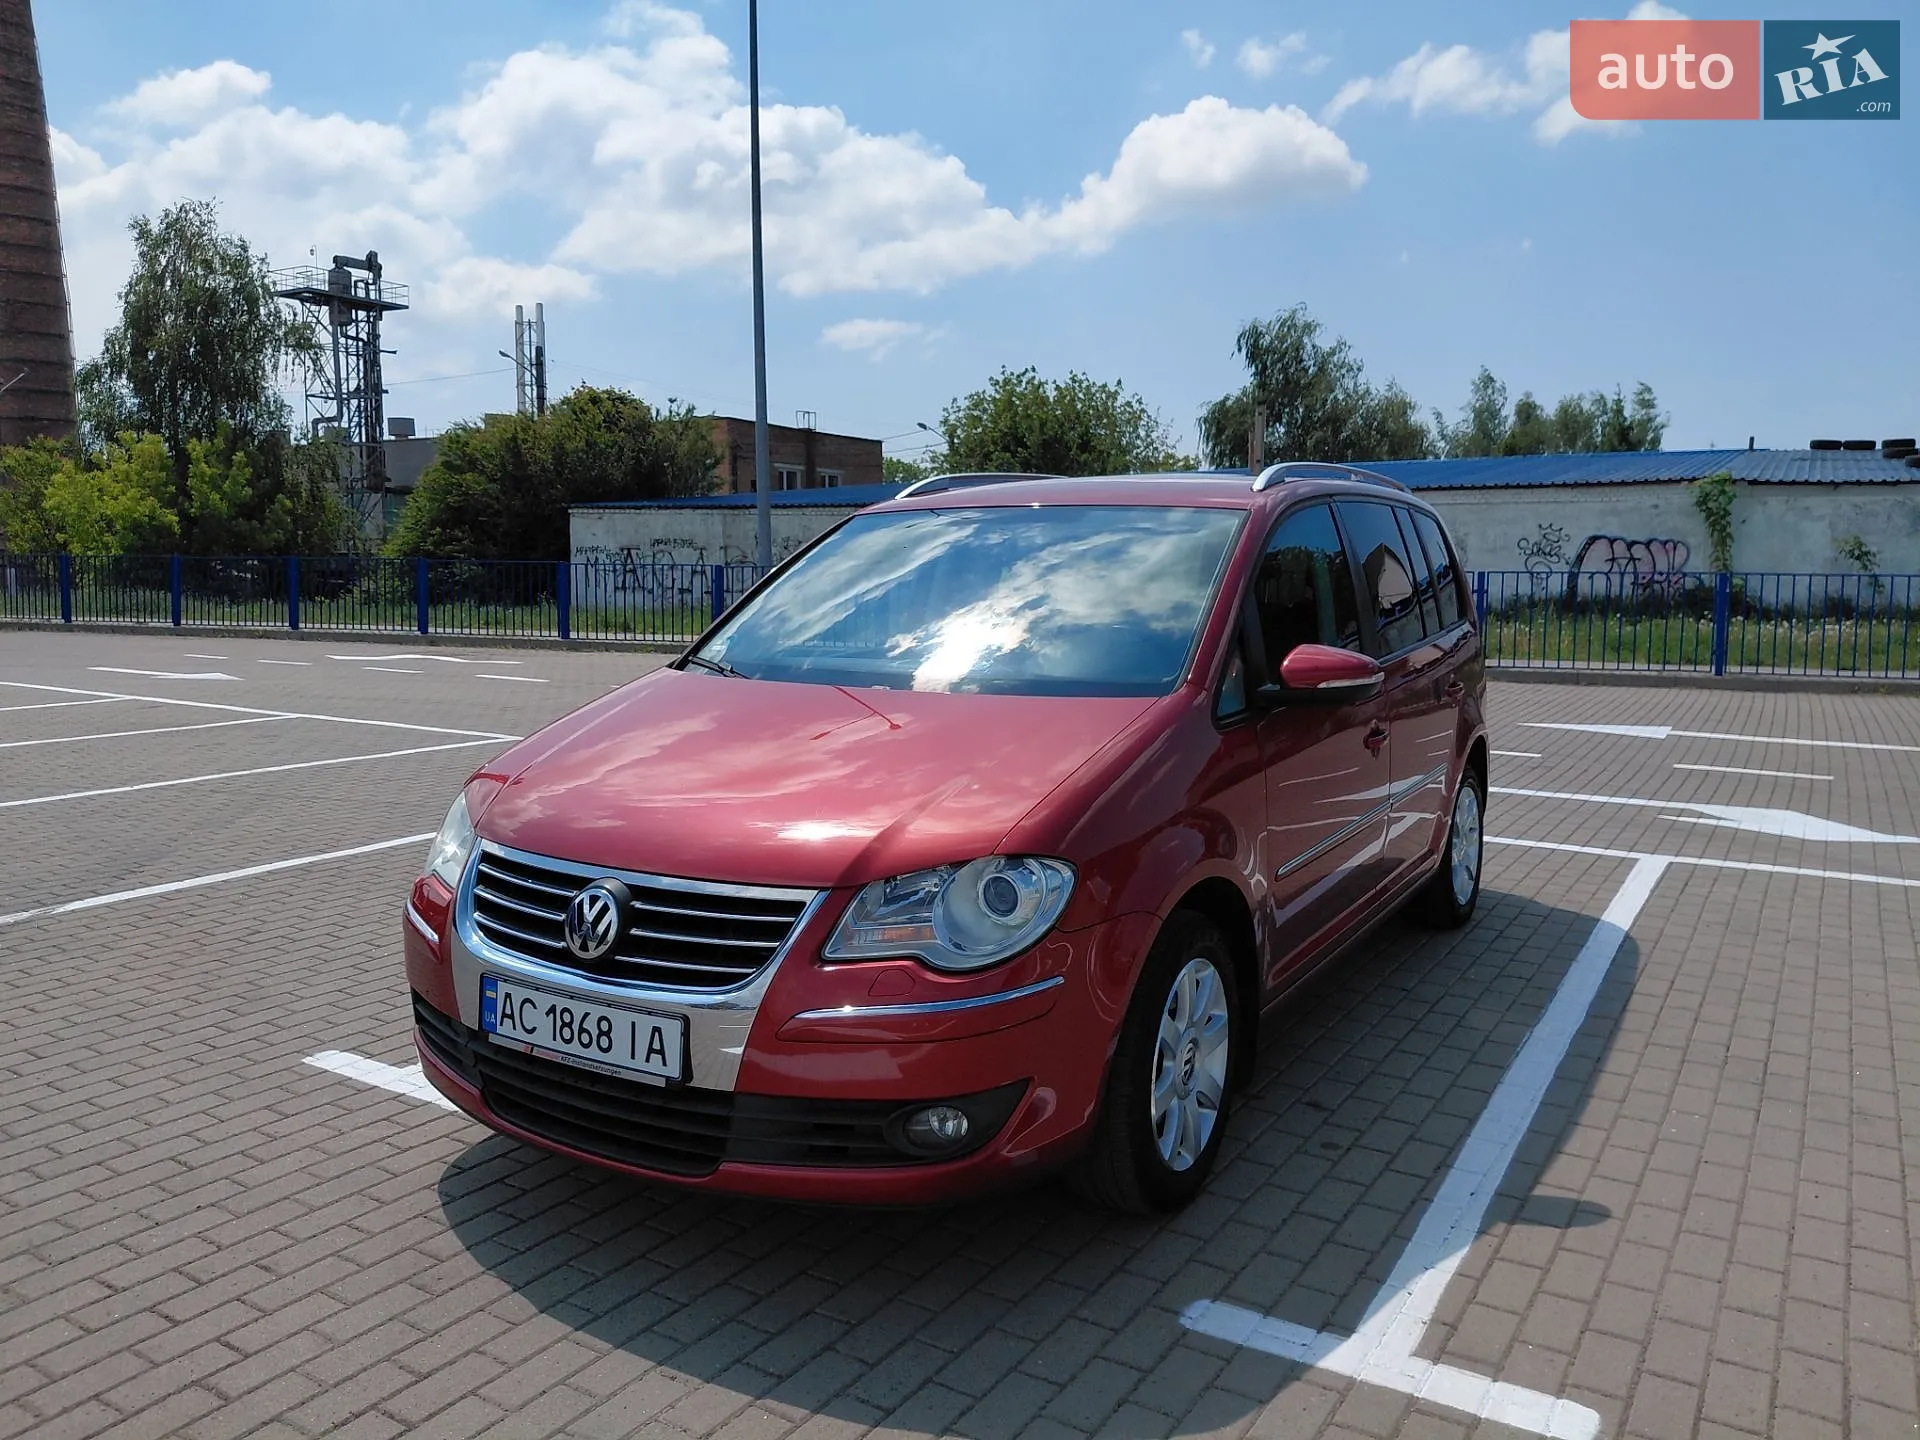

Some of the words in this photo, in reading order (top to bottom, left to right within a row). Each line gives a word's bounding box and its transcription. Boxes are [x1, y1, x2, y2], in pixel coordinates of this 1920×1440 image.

[484, 1011, 496, 1024] UA
[500, 991, 538, 1034] AC
[545, 1004, 613, 1054] 1868
[630, 1020, 668, 1067] IA
